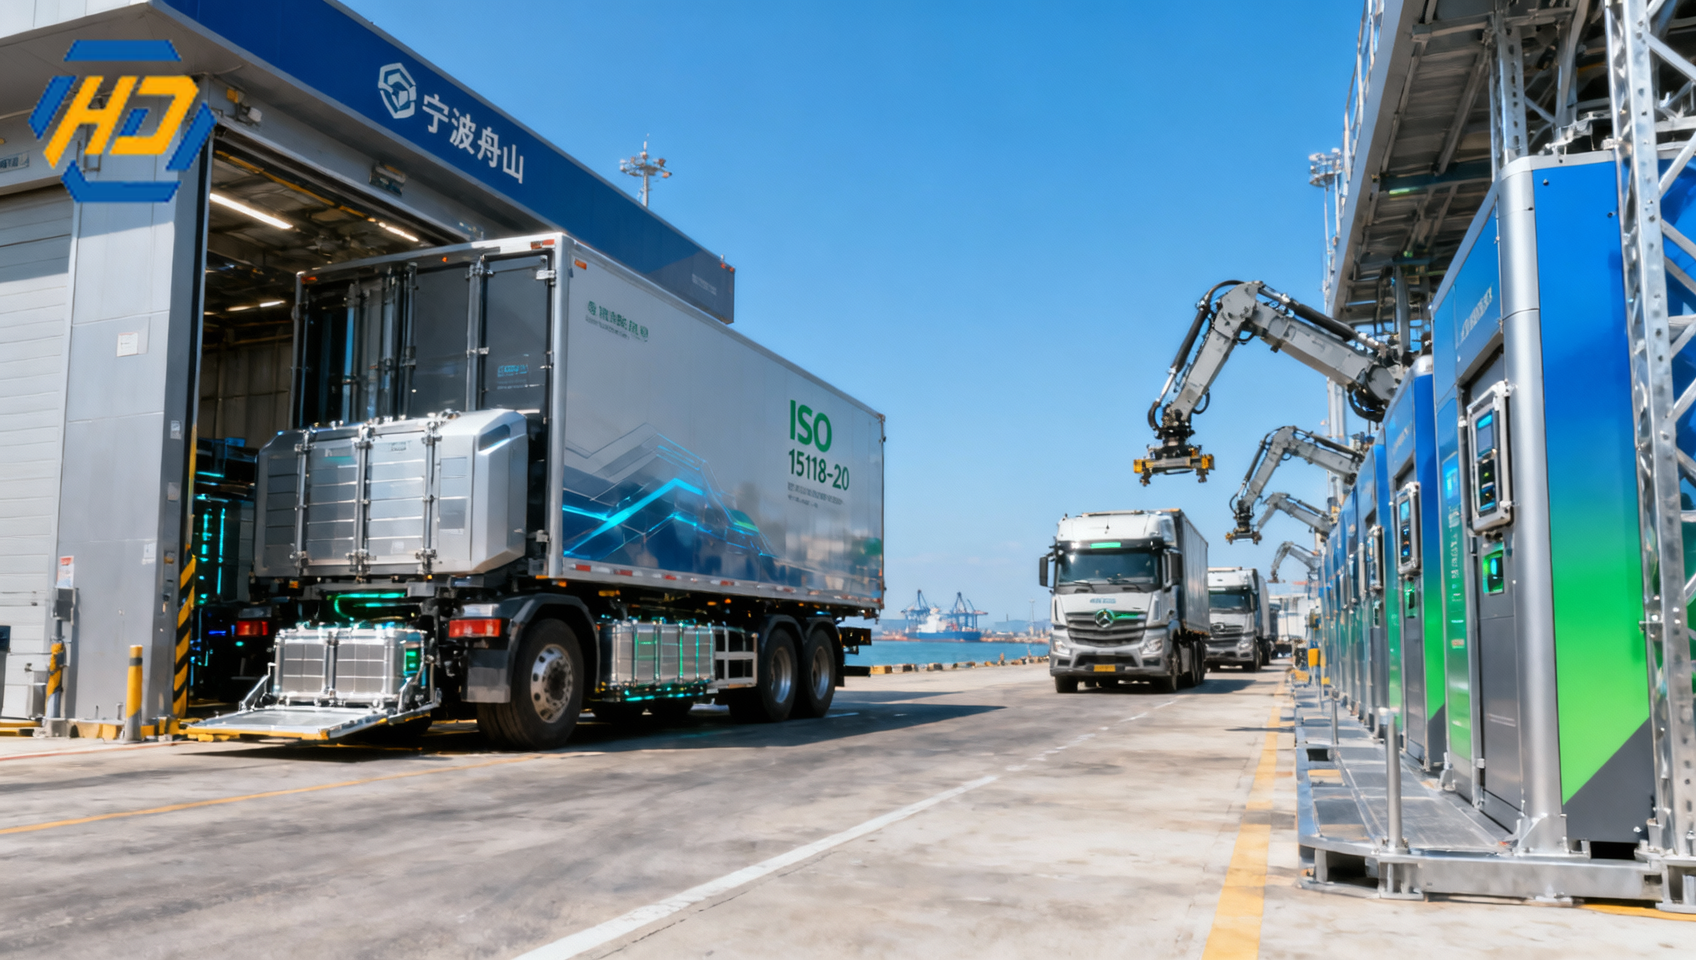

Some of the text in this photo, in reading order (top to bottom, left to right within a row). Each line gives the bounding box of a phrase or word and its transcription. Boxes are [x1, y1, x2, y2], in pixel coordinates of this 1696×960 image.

[422, 94, 524, 184] 宁波舟山
[790, 399, 833, 453] ISO
[788, 448, 850, 491] 15118-20
